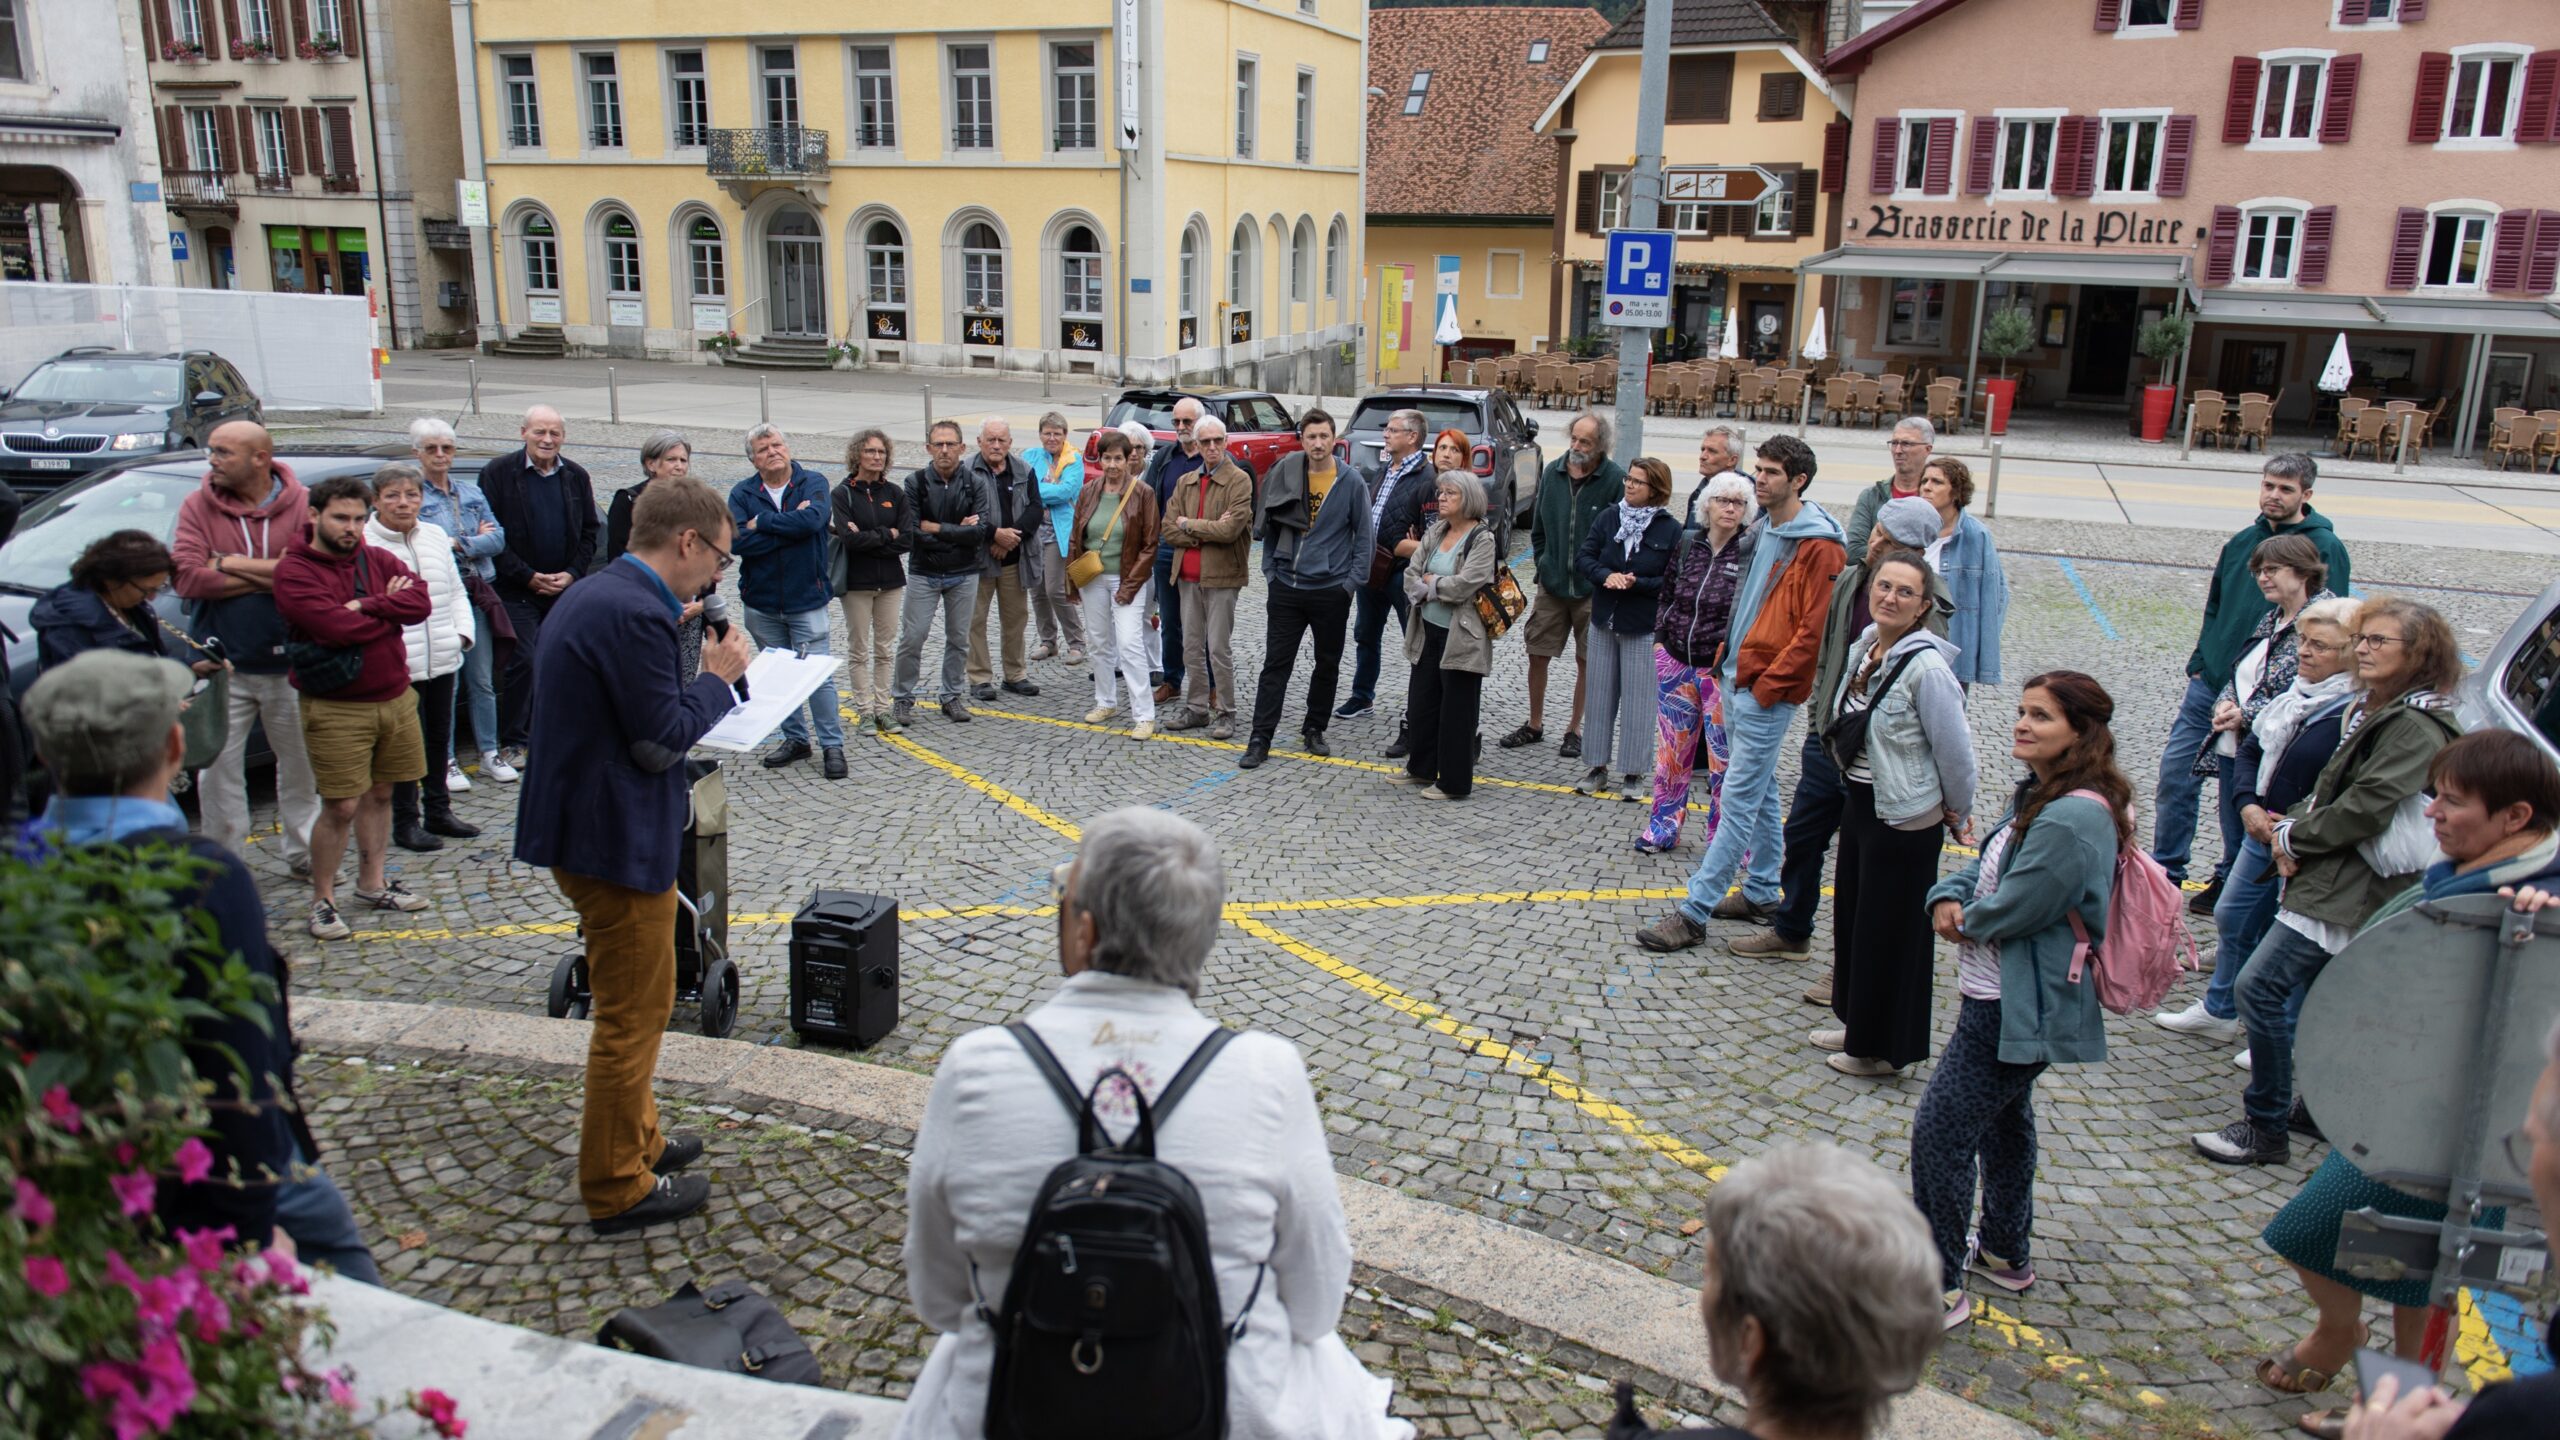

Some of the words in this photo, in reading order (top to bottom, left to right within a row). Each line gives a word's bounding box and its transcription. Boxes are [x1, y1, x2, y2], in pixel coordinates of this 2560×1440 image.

[1866, 205, 2011, 240] Brasserie
[2021, 210, 2049, 242] de
[2060, 210, 2083, 243] la
[2094, 210, 2183, 248] Place
[1620, 241, 1651, 285] P
[1625, 309, 1662, 318] 05.00-13.00
